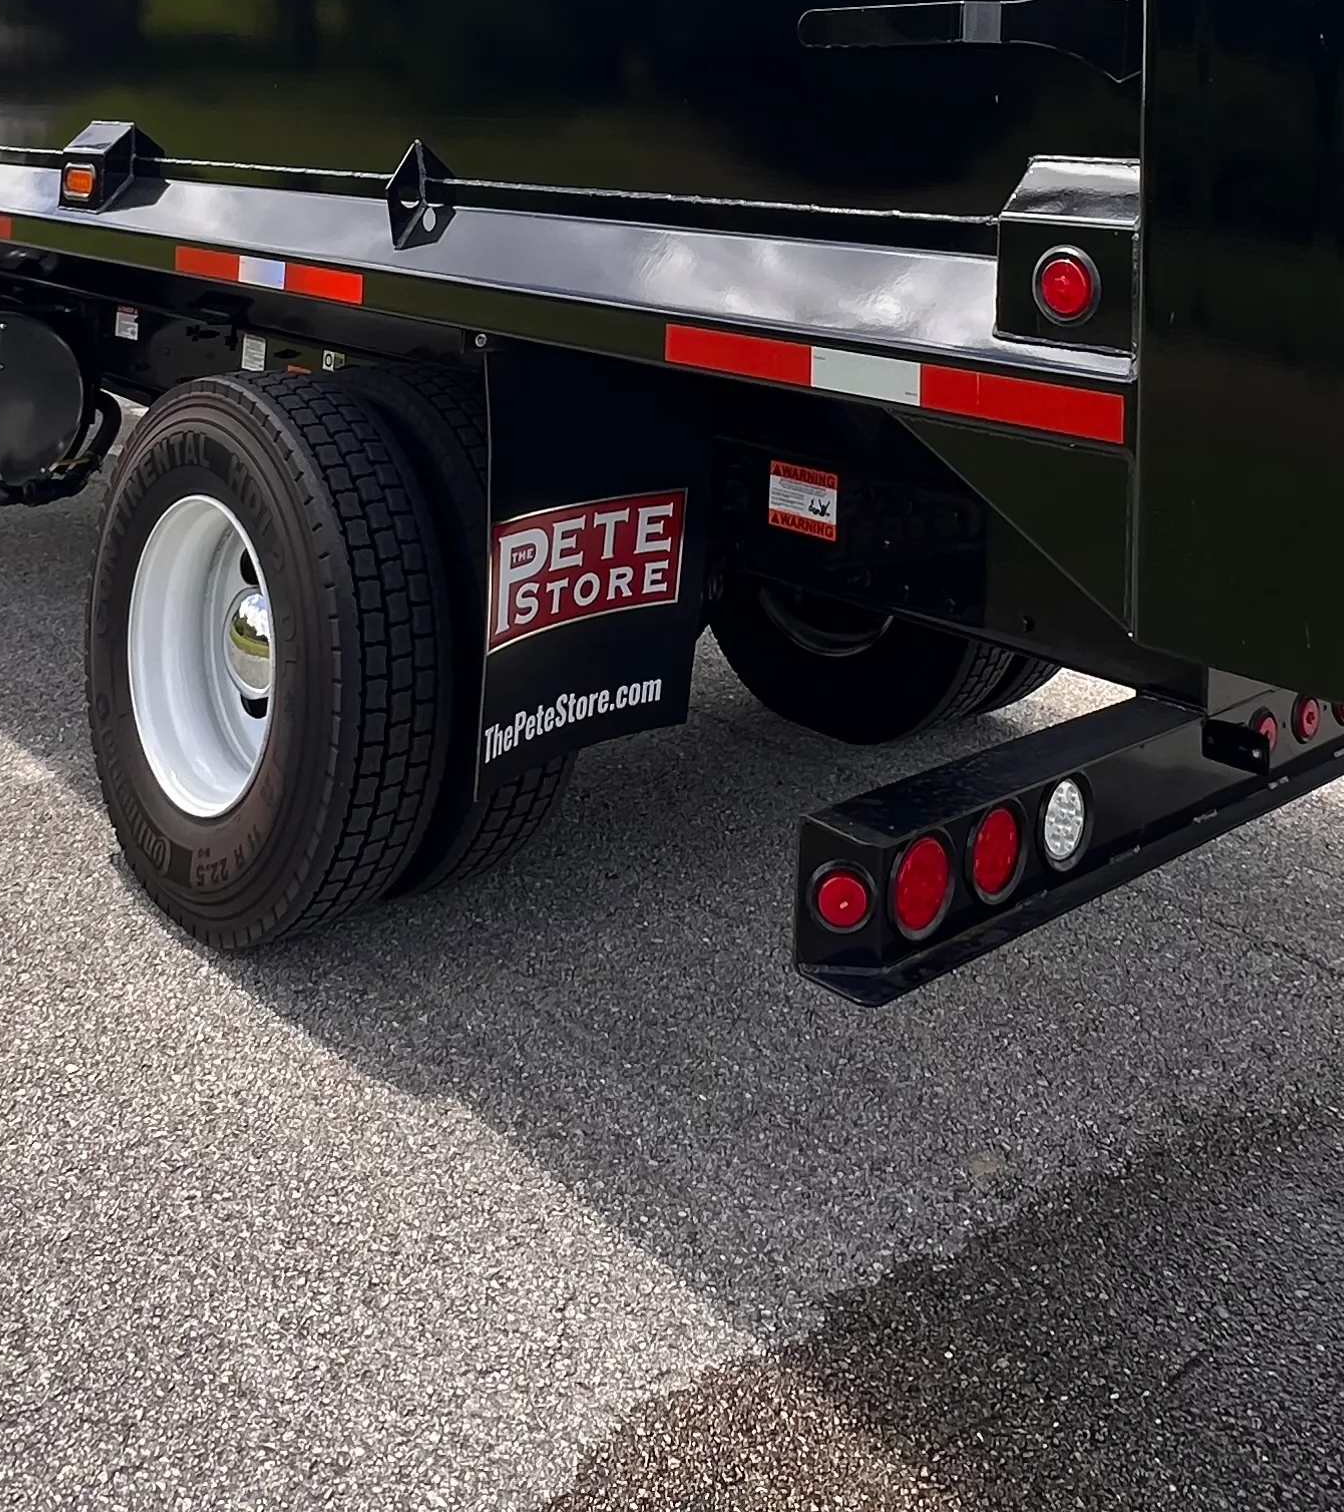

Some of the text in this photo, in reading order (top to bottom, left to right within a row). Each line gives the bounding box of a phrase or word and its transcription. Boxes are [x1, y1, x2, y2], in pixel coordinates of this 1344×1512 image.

[782, 464, 836, 489] WARNING
[780, 512, 835, 538] WARNING
[494, 501, 675, 636] PETE
[511, 547, 534, 564] THE
[513, 558, 670, 627] STORE
[484, 677, 663, 765] ThePeteStore.com
